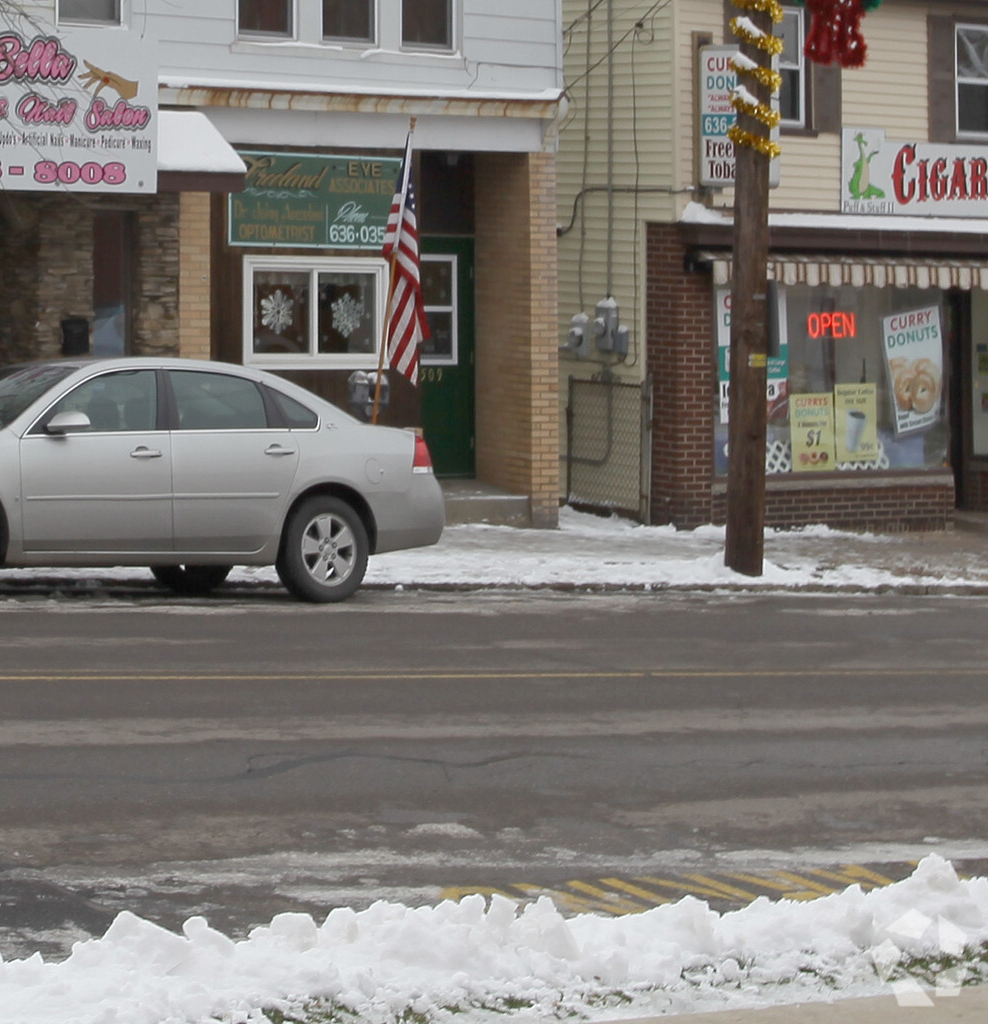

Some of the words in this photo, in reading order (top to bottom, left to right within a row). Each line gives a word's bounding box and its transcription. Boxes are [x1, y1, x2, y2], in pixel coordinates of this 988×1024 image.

[16, 93, 77, 125] Nail
[85, 97, 150, 132] Salon
[22, 132, 48, 147] Artificial
[70, 134, 95, 148] Manicure
[101, 135, 125, 149] Pedicure
[131, 136, 151, 153] Waxing
[348, 161, 383, 177] EYE
[329, 177, 396, 195] ASSOCIATES
[333, 201, 369, 223] Phone
[238, 223, 315, 242] OPTOMETRIST
[807, 312, 856, 338] OPEN
[890, 310, 931, 331] CURRY
[887, 325, 938, 348] DONUTS
[795, 407, 828, 418] DONUTS
[806, 429, 822, 448] $1
